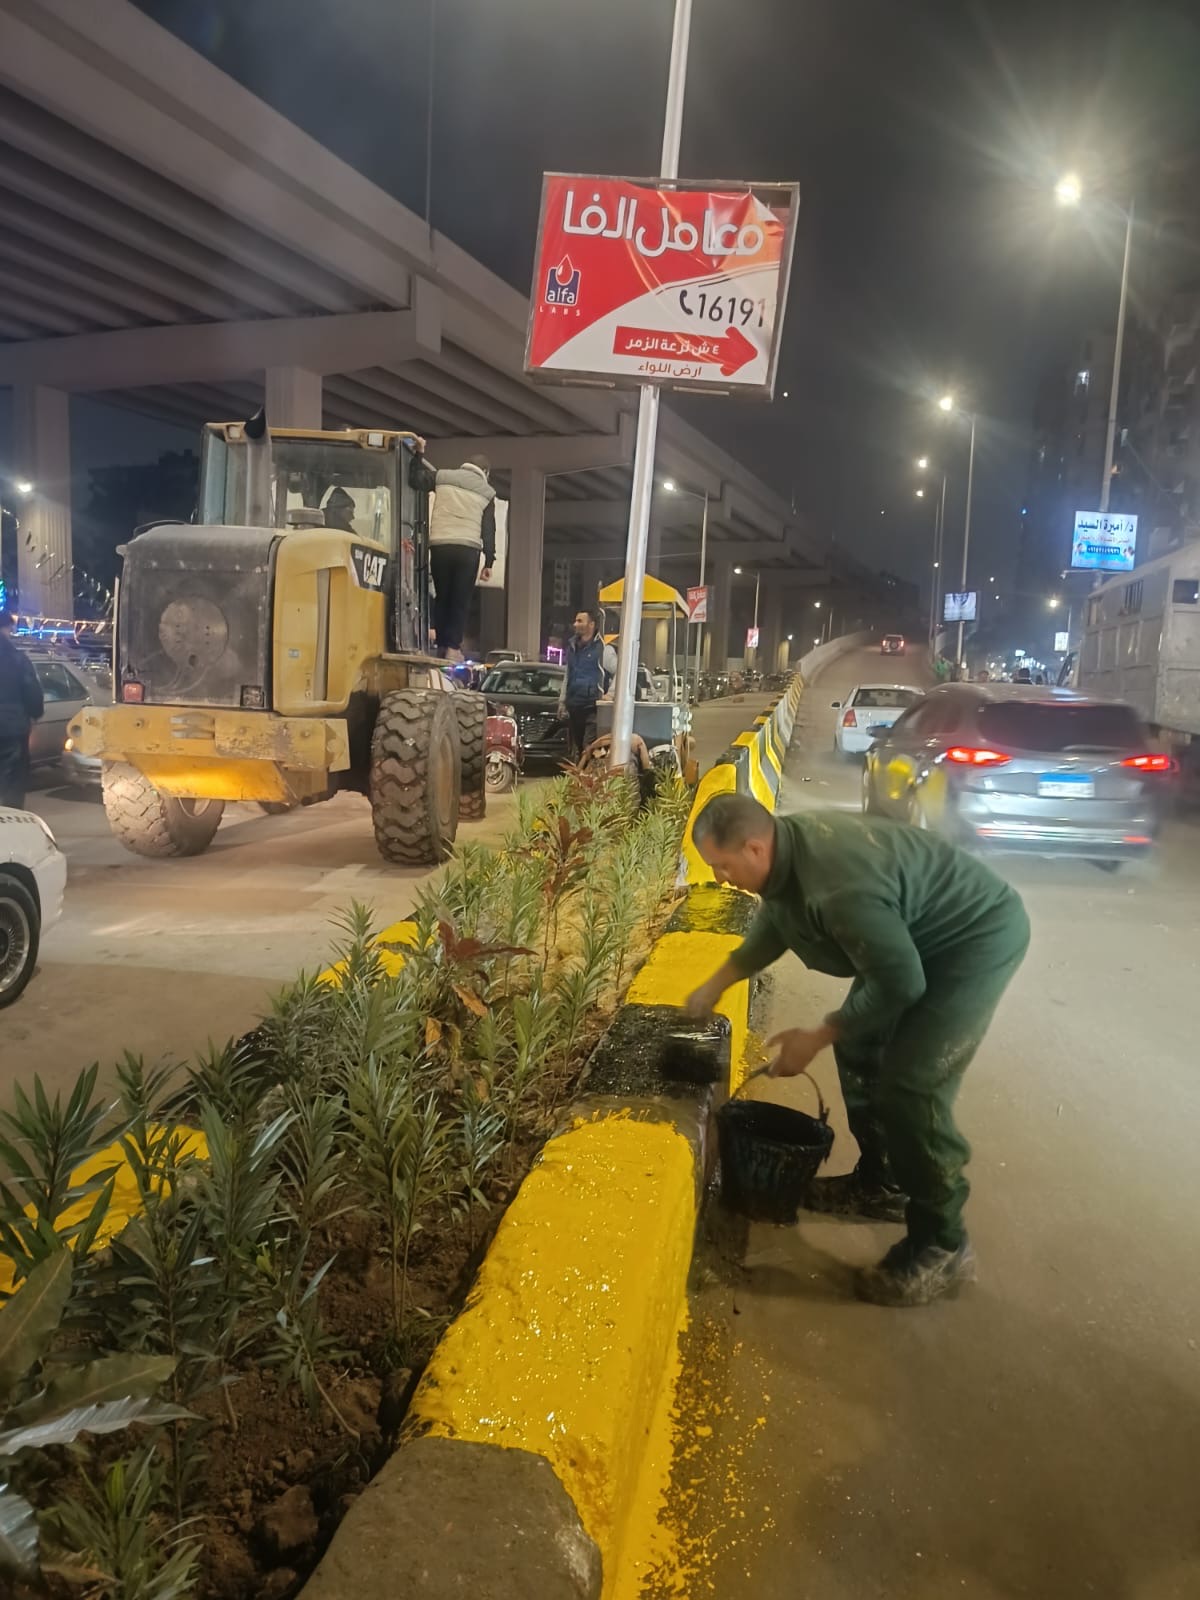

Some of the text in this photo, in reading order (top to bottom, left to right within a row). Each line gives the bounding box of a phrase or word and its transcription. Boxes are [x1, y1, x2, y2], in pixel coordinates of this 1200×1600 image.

[563, 190, 764, 257] معامل الفا
[547, 287, 575, 304] alfa
[699, 293, 766, 328] 16191
[625, 336, 659, 352] الزمر
[638, 361, 702, 378] ارض اللواء
[363, 552, 387, 587] CAT
